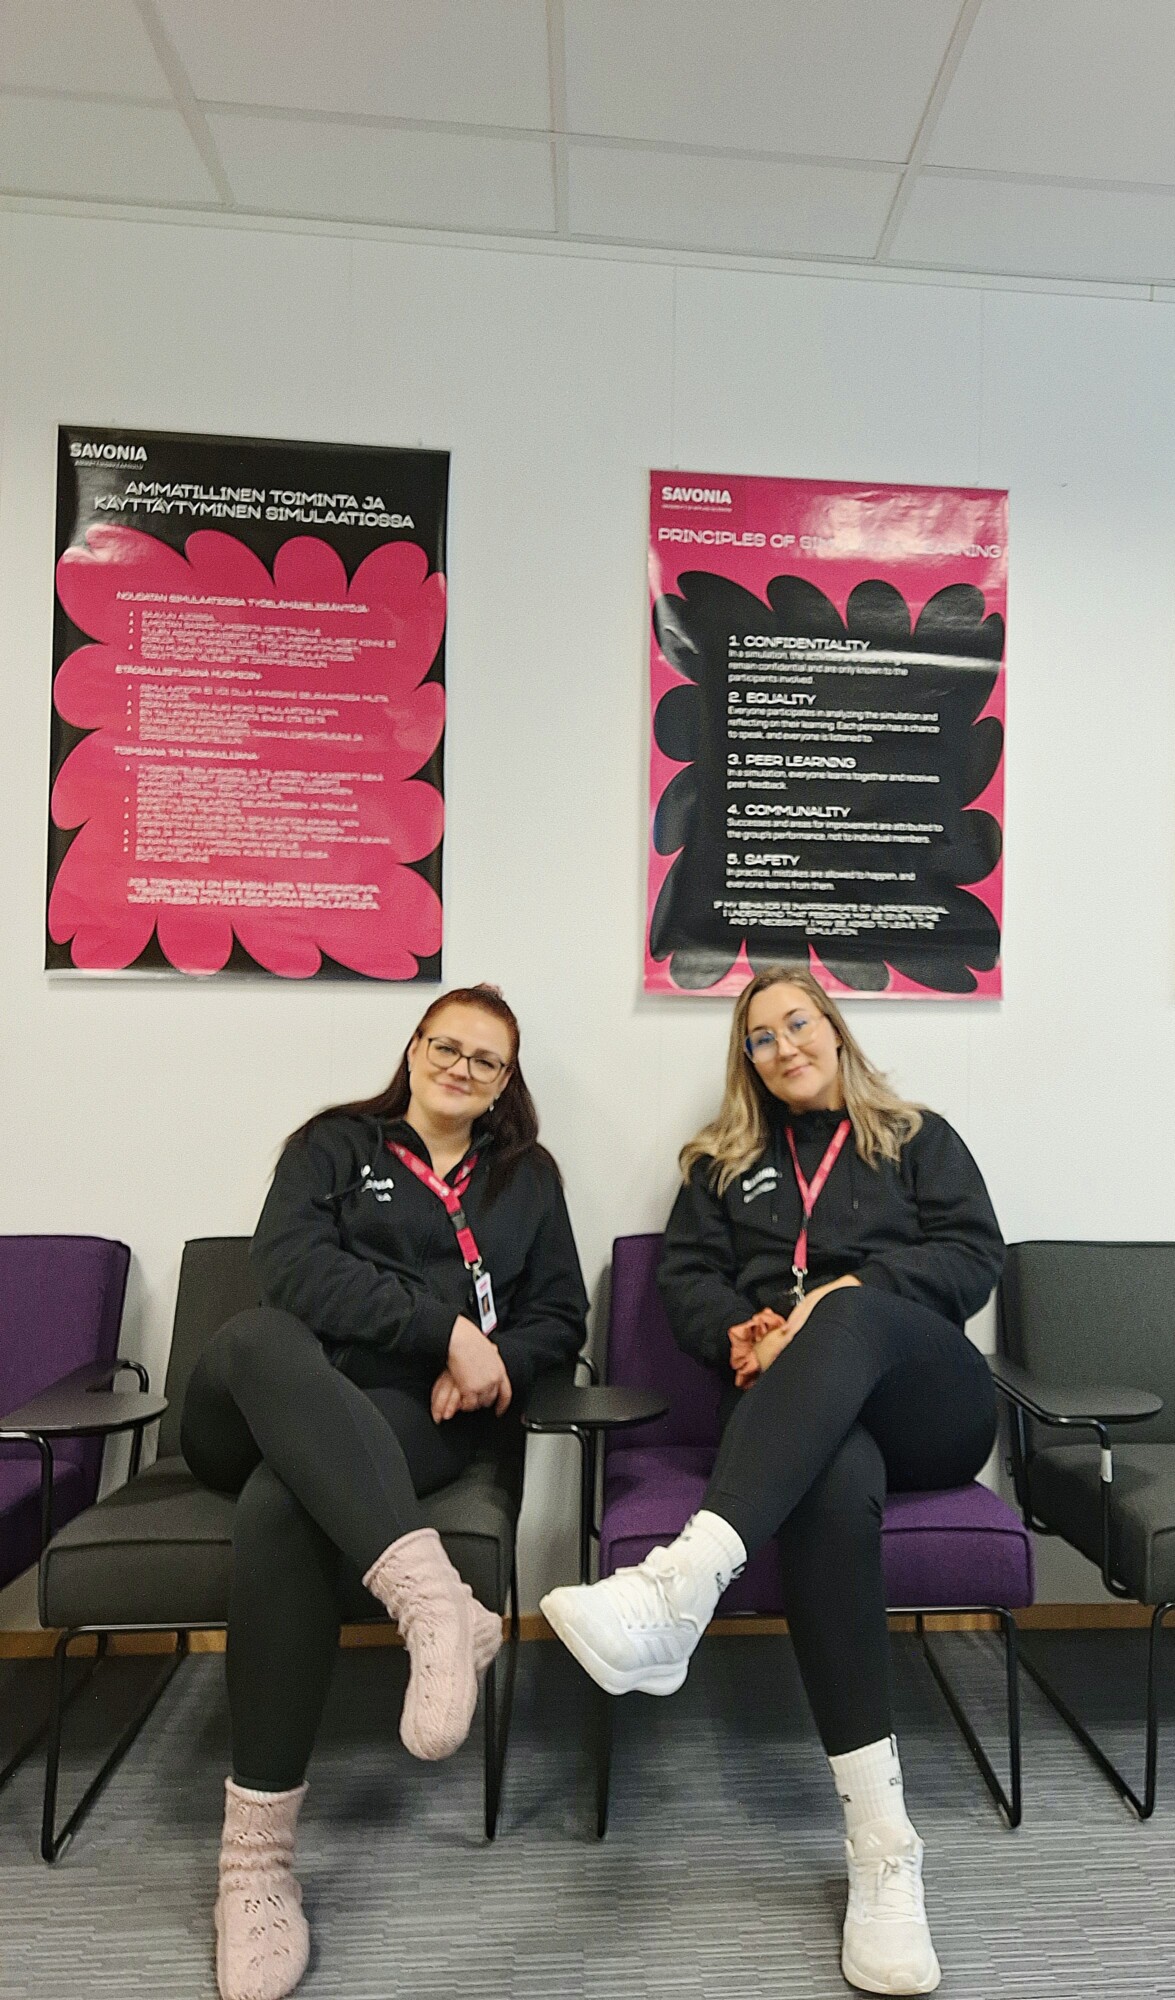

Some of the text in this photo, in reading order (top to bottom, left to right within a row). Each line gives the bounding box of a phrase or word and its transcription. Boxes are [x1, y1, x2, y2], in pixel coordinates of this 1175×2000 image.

[70, 442, 148, 462] SAVONIA
[125, 480, 386, 511] AMMATILLINEN TOIMINTA JA
[661, 486, 732, 504] SAVONIA
[94, 494, 415, 529] KÄYTTÄYTYMINEN SIMULAATIOSSA
[658, 527, 766, 548] PRINCIPLES
[769, 533, 796, 549] OF
[743, 635, 871, 652] CONFIDENTIALITY
[746, 692, 817, 705] EQUALITY
[727, 753, 857, 769] 3. PEER LEARNING
[727, 804, 851, 817] 4. COMMUNALITY
[727, 853, 800, 866] 5. SAFETY
